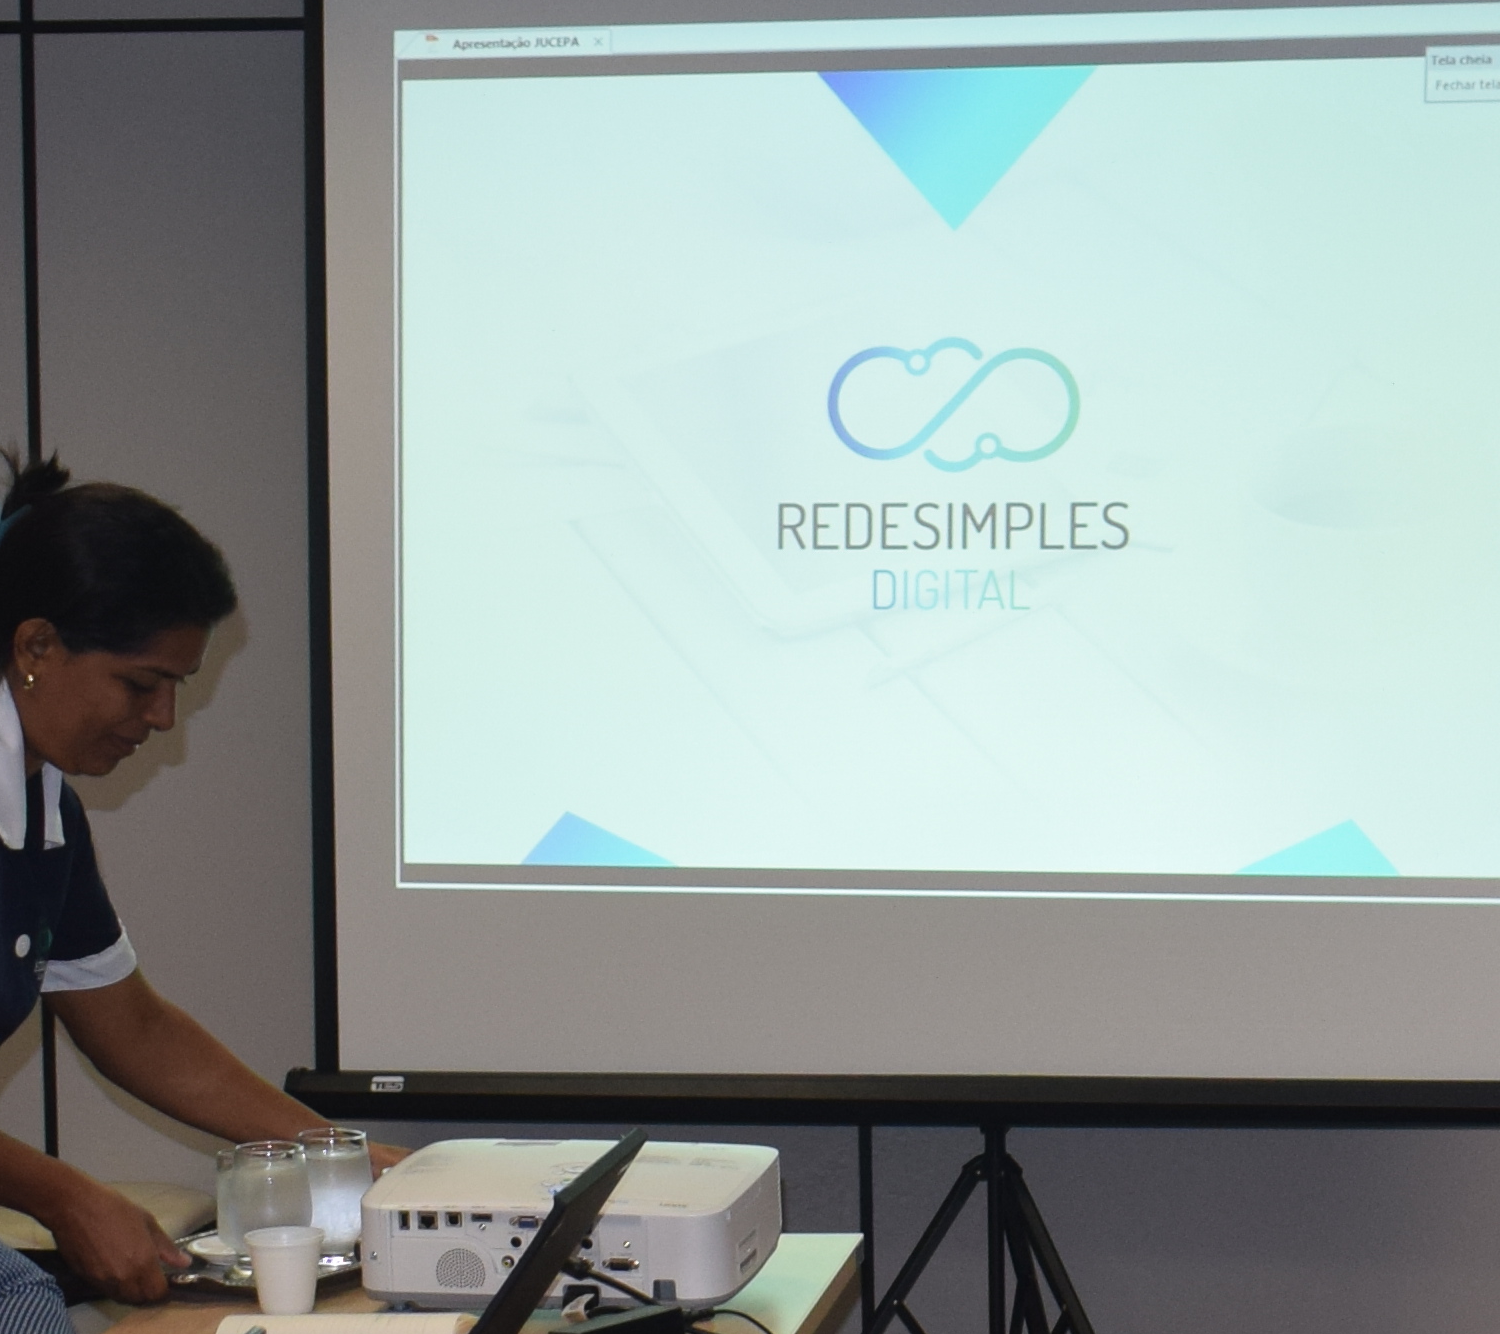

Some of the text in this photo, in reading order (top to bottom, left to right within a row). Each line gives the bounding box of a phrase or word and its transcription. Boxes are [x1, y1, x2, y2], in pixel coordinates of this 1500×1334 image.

[453, 37, 579, 50] Apresentação JUCEPA
[1432, 55, 1493, 66] Tela cheia
[1435, 80, 1475, 91] Fechar
[777, 502, 1130, 550] REDESIMPLES
[872, 569, 1031, 610] DIGITAL
